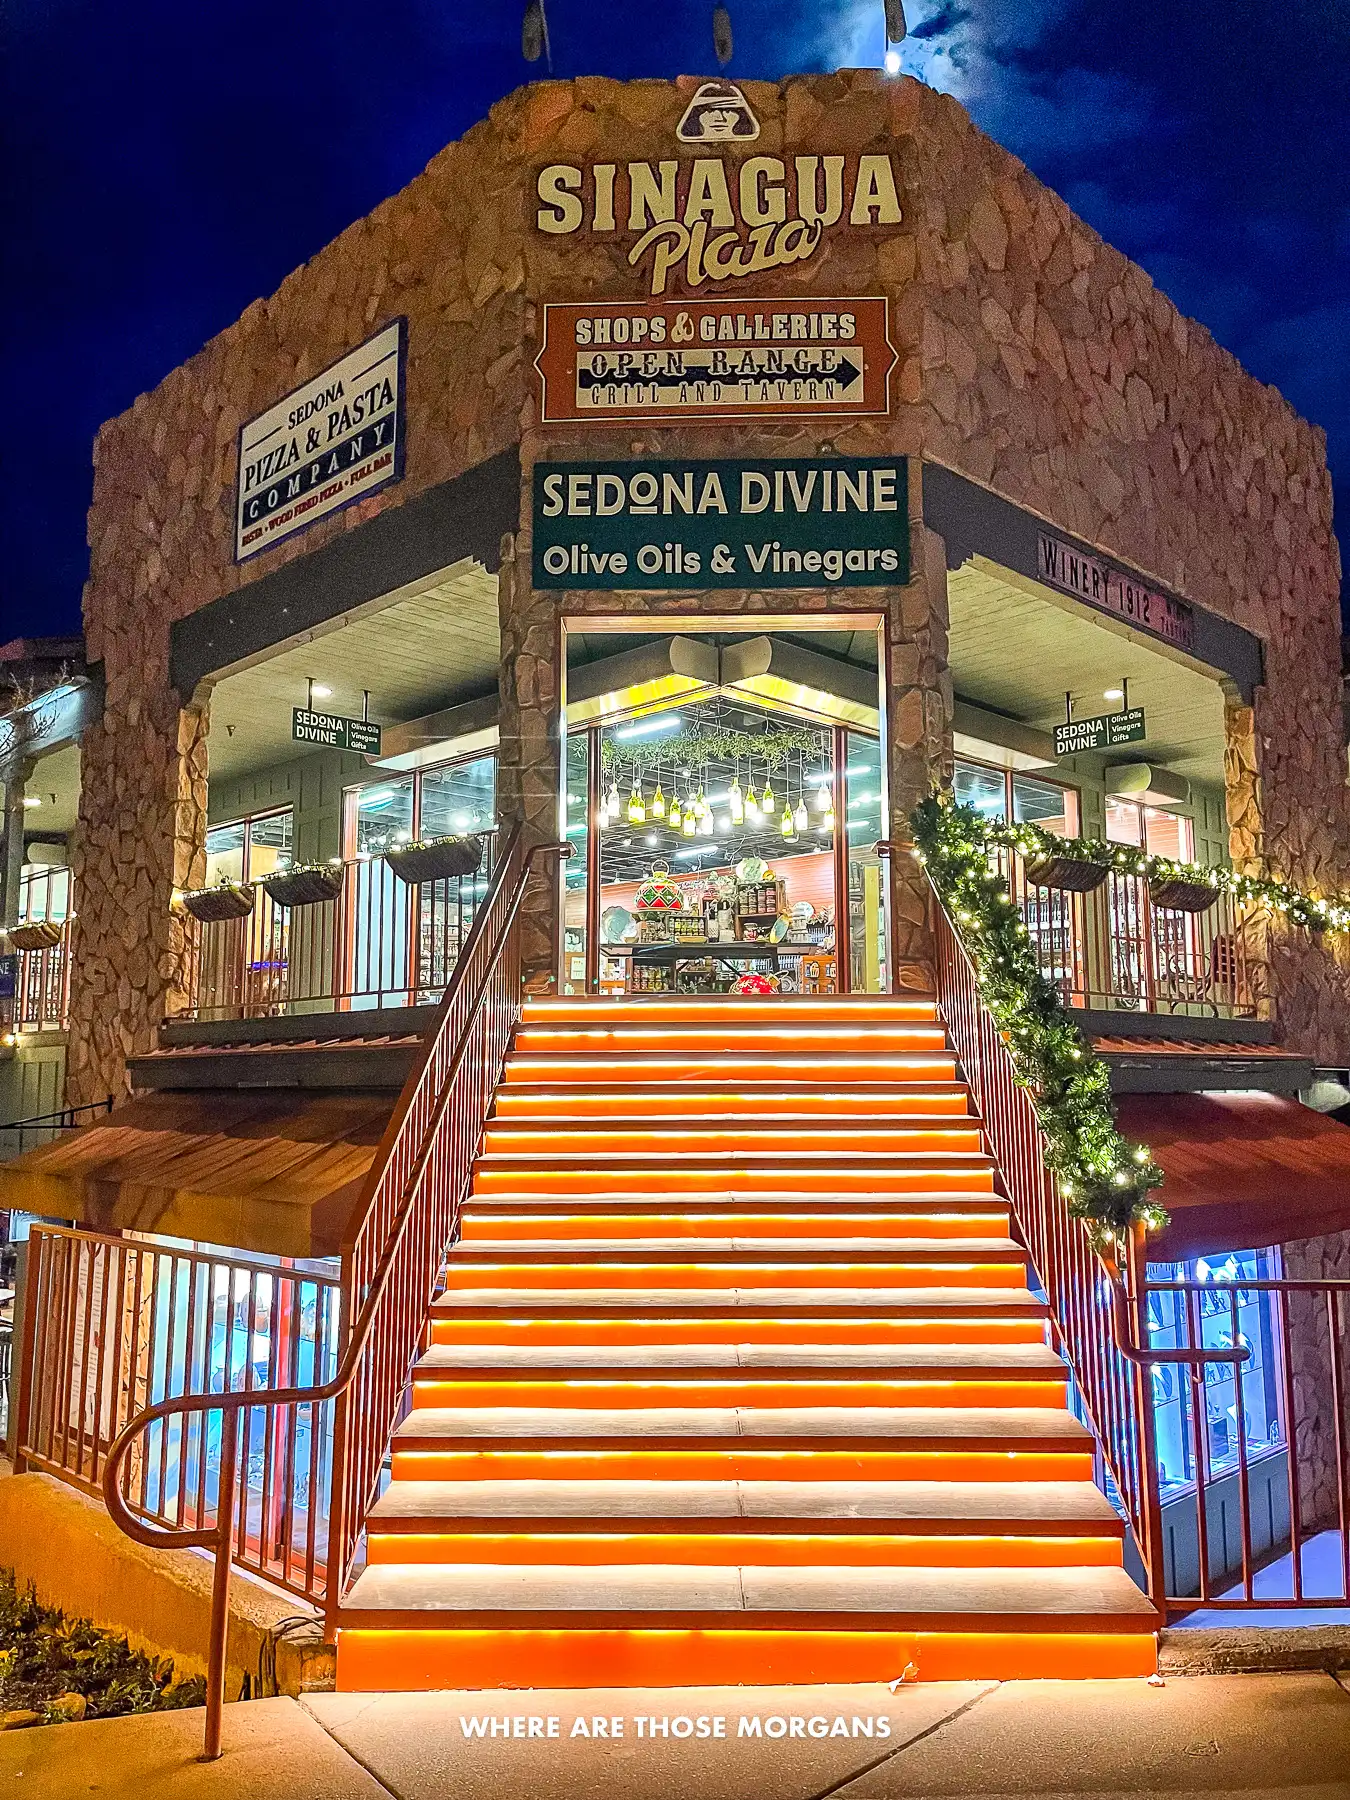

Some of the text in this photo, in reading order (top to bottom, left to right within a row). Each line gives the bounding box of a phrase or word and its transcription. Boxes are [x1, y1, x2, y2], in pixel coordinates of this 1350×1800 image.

[537, 155, 902, 233] SINAGUA
[628, 219, 823, 295] Plaza
[575, 312, 856, 344] SHOPS & GALLERIES
[590, 349, 837, 377] OPEN RANGE
[591, 381, 835, 404] GRILL AND TAVERN
[287, 380, 345, 431] SEDONA
[244, 377, 395, 493] PIZZA & PASTA
[249, 423, 386, 518] COMPANY
[542, 469, 898, 516] SEDONA DIVINE
[268, 509, 293, 530] WOOD
[319, 481, 343, 503] PIZZA
[543, 541, 898, 580] Olive Oils & Vinegars
[1042, 536, 1110, 603] WINERY
[1119, 581, 1151, 623] 1912
[296, 711, 344, 731] SEDONA
[351, 722, 379, 734] Olive Oils
[1056, 719, 1104, 740] SEDONA
[1111, 711, 1142, 723] Olive Oils
[1112, 722, 1141, 732] Vinegars
[296, 725, 337, 744] DIVINE
[351, 732, 378, 743] Vinegars
[351, 741, 367, 750] Gifts
[1057, 735, 1098, 754] DIVINE
[1112, 734, 1129, 742] Gifts
